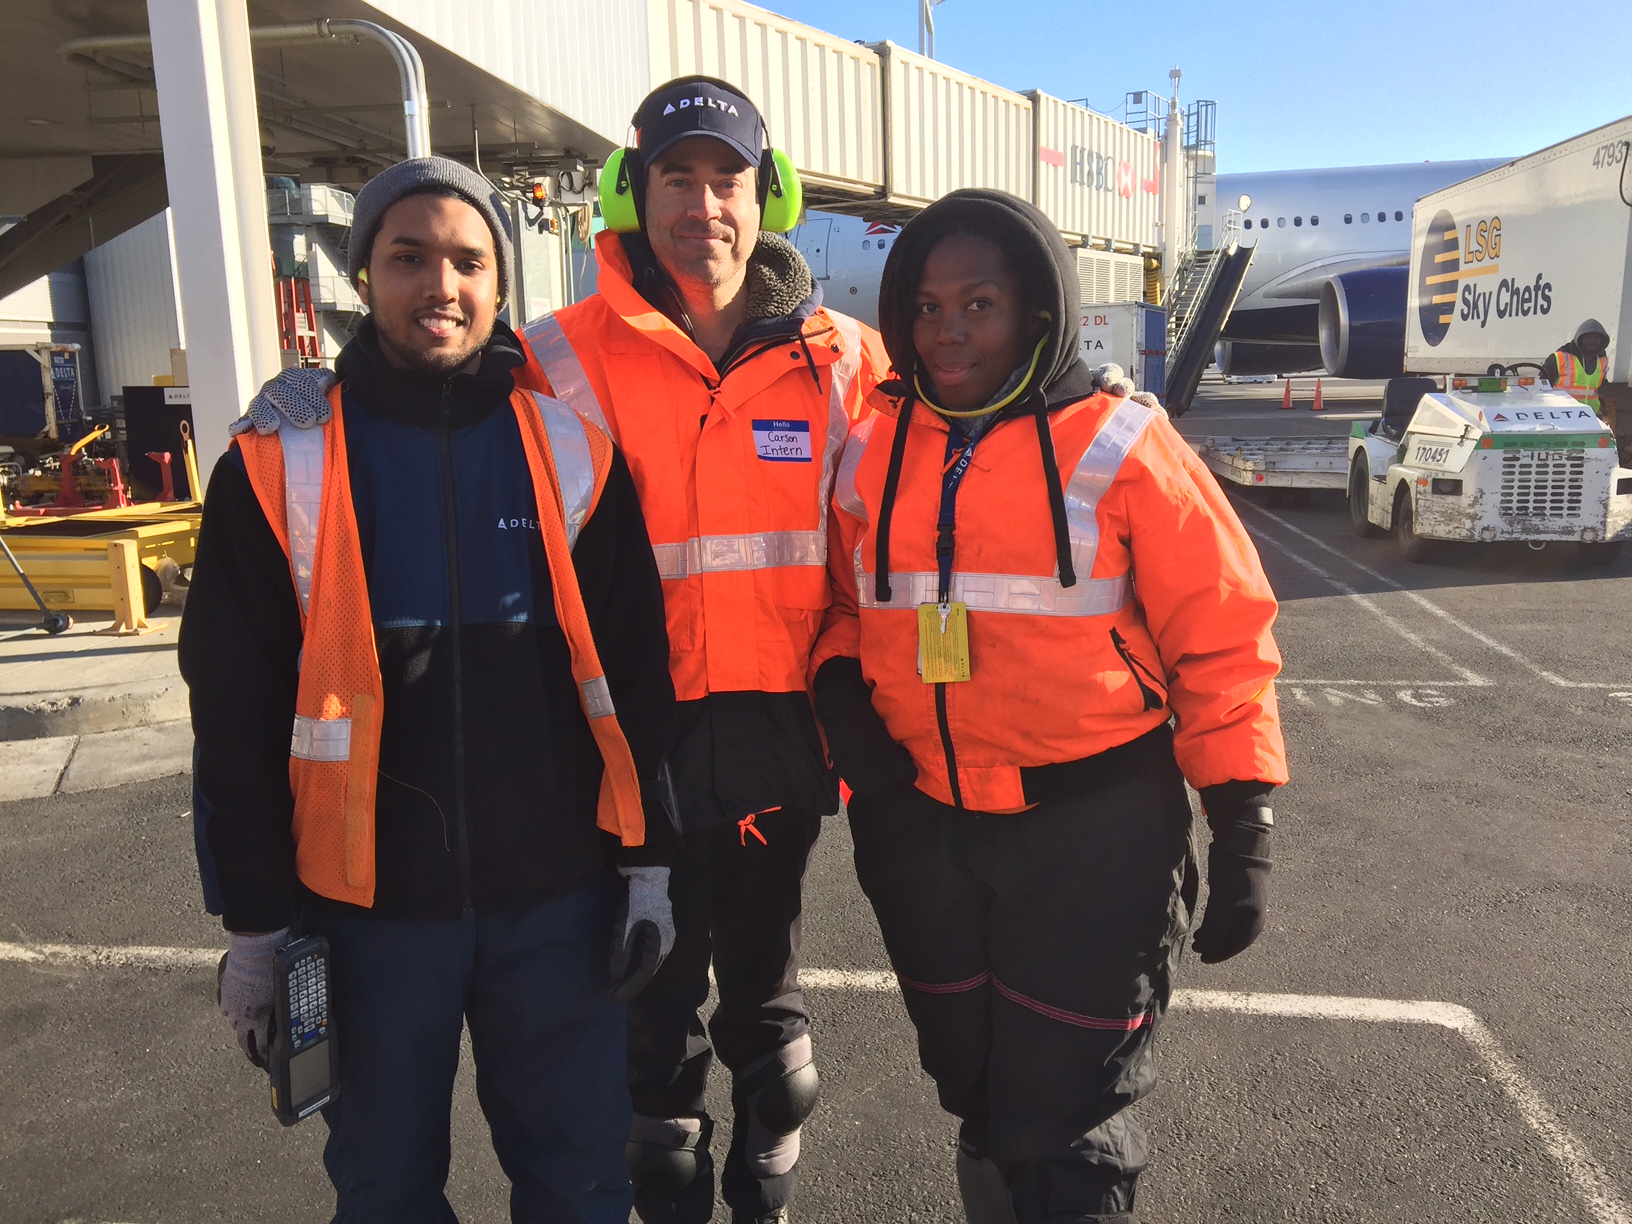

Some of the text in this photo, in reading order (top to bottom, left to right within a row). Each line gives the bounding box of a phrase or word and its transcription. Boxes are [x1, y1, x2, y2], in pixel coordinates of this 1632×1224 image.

[680, 97, 739, 117] DELTA
[1070, 144, 1116, 193] HSBC
[1464, 216, 1502, 264] LSG
[1460, 273, 1552, 328] Sky Chefs
[1094, 315, 1109, 325] DL
[1079, 340, 1104, 350] TA
[55, 367, 75, 378] DELTA
[1515, 410, 1591, 420] DELTA
[768, 431, 798, 443] Carson
[760, 445, 803, 456] Intern
[1415, 446, 1450, 464] 170451
